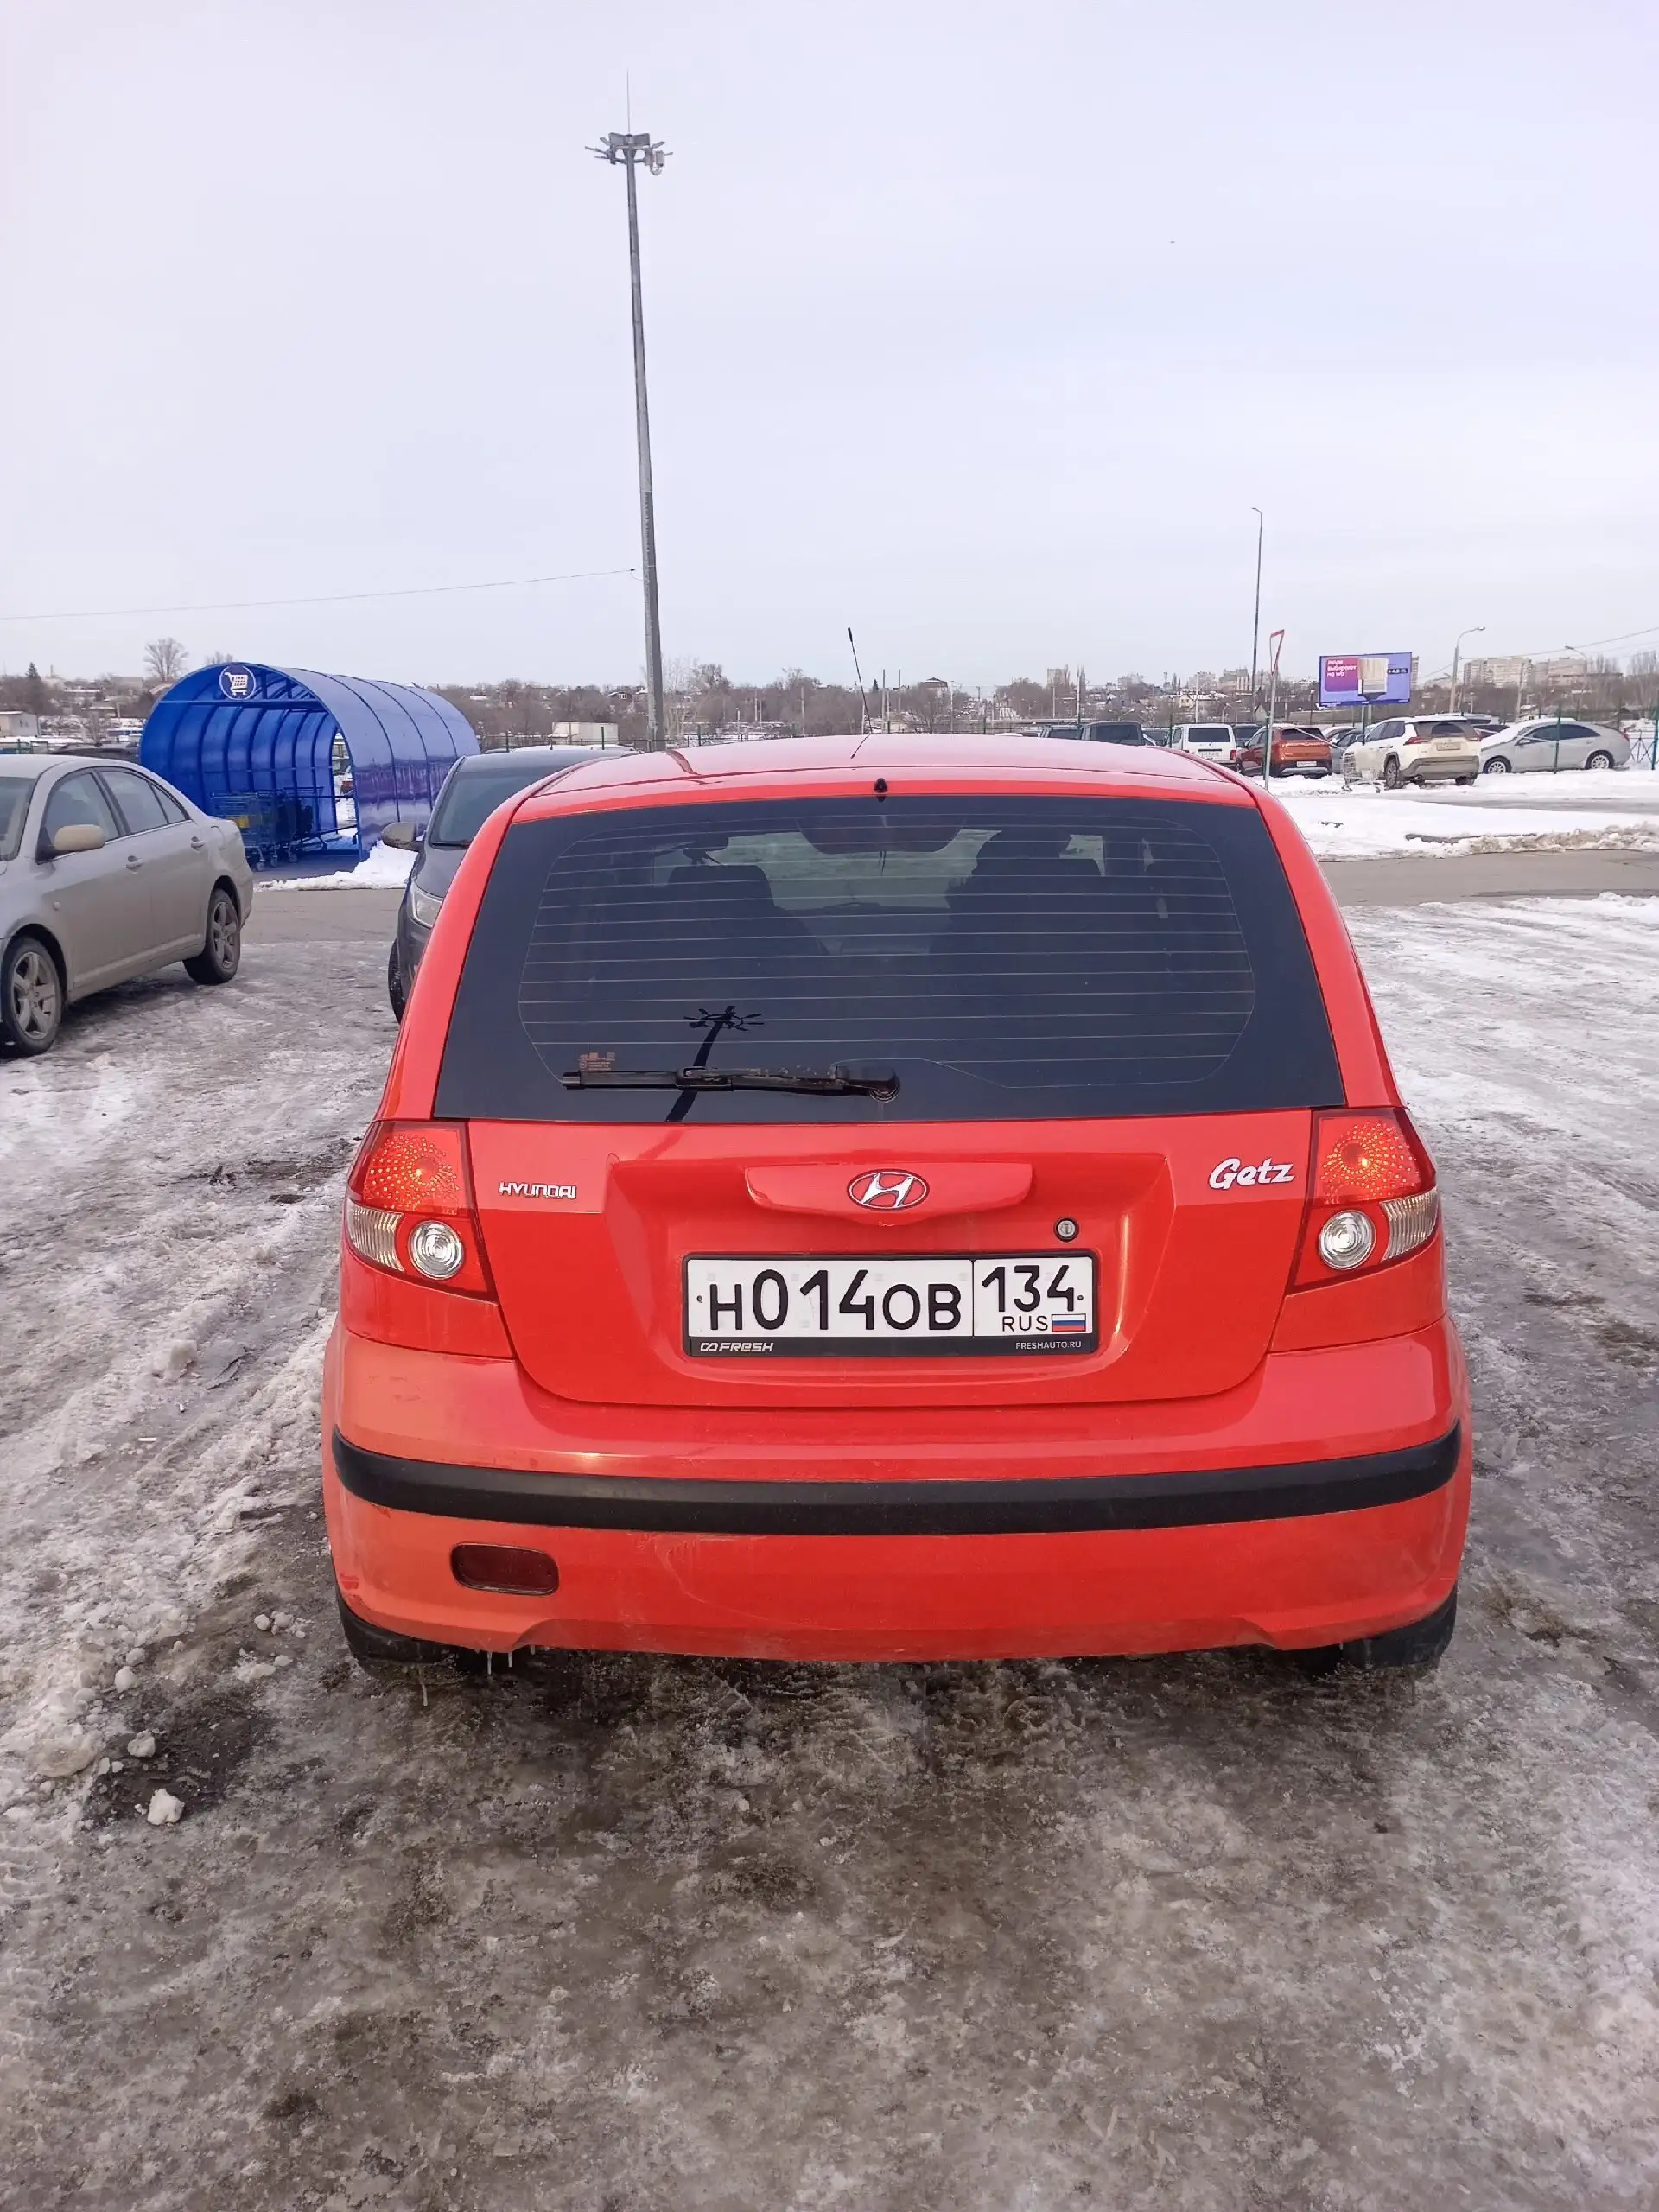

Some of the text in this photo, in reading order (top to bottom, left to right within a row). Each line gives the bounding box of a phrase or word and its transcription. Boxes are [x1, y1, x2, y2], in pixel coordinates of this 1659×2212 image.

[1209, 1157, 1295, 1190] Getz
[499, 1181, 577, 1199] HYUNDAI
[981, 1264, 1075, 1313] 134
[1001, 1315, 1049, 1332] RUS
[1015, 1340, 1082, 1350] FRESHAUTO.RU
